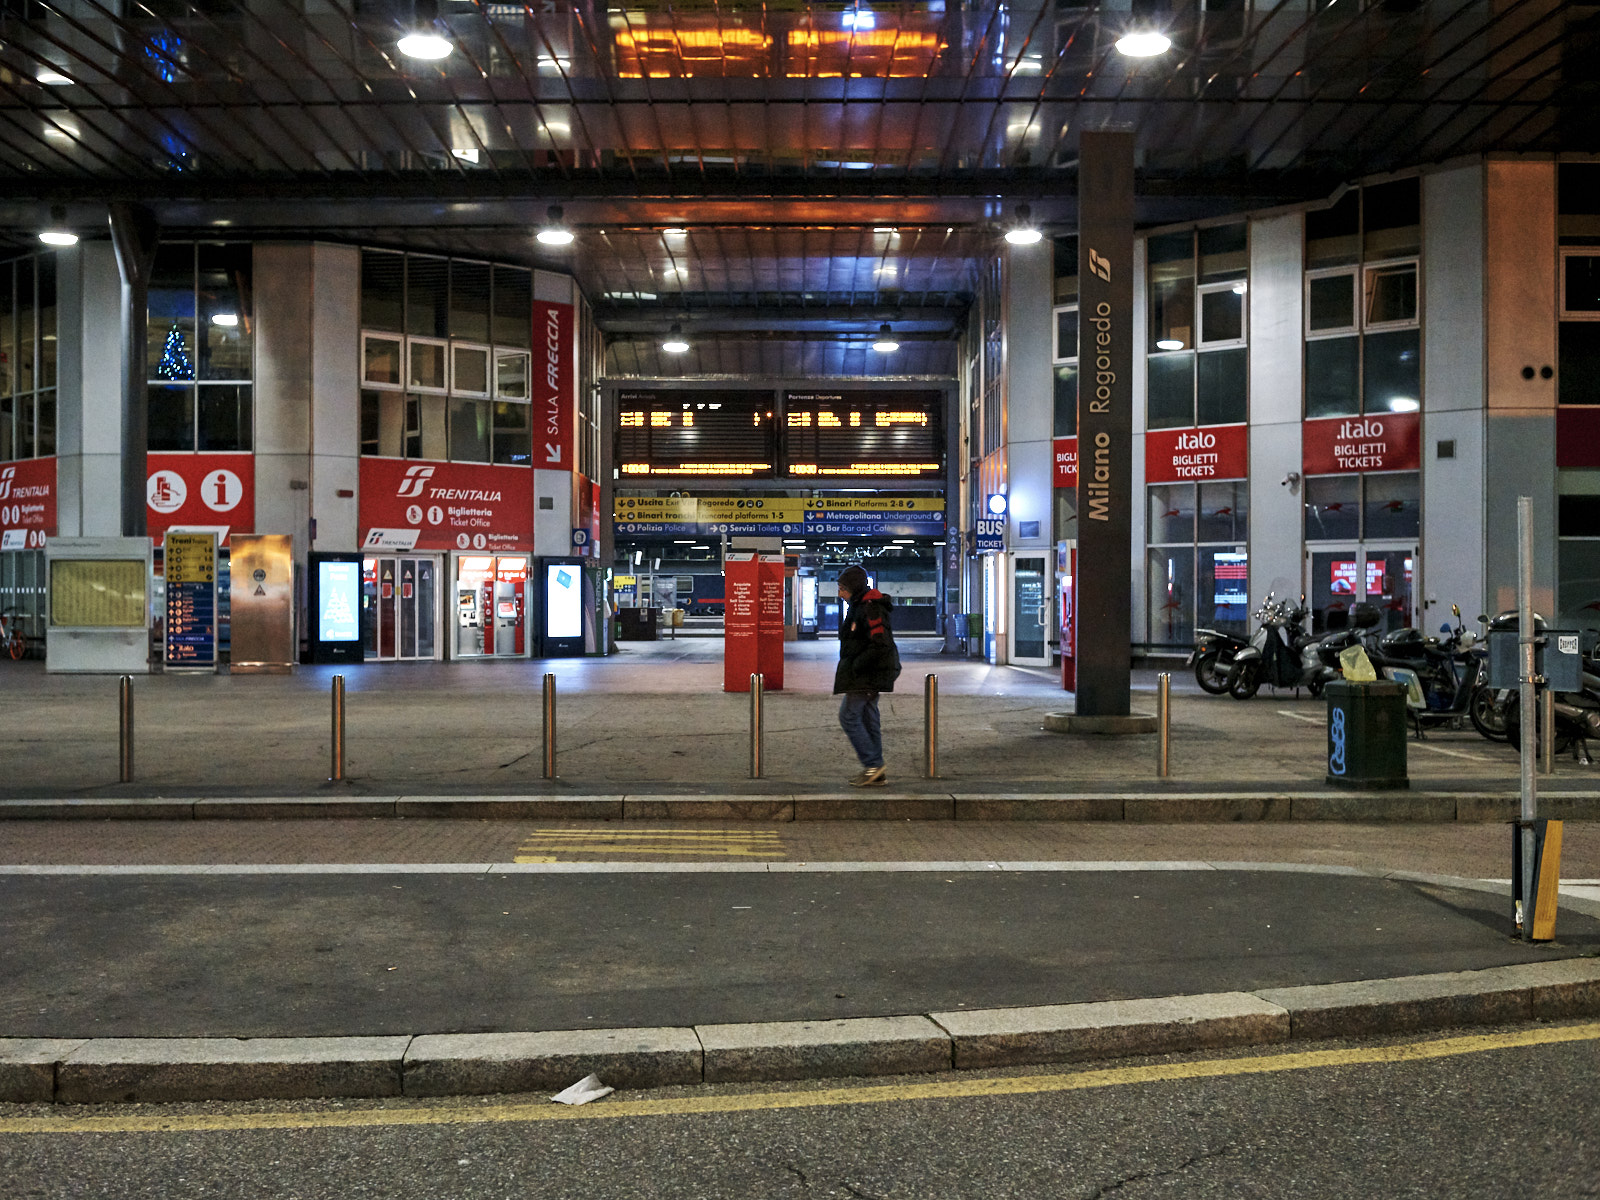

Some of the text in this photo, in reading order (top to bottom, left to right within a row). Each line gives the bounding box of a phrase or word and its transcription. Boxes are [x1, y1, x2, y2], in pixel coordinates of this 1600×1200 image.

[548, 309, 559, 435] SALA FRECCIA
[1088, 302, 1116, 521] Milano Rogoredo
[1334, 442, 1386, 456] BIGLIETTI
[1172, 452, 1218, 466] BIGLIETTI
[1338, 456, 1382, 468] TICKETS
[1176, 464, 1214, 477] TICKETS
[13, 484, 50, 498] TRENITALIA
[430, 488, 502, 502] TRENITALIA
[698, 499, 734, 508] Rogoredo
[448, 506, 492, 517] Biglietteria
[735, 512, 768, 520] platforms
[884, 512, 932, 520] Underground
[450, 518, 490, 528] Ticket Office
[977, 520, 1003, 536] BUS
[488, 534, 518, 542] Biglietteria
